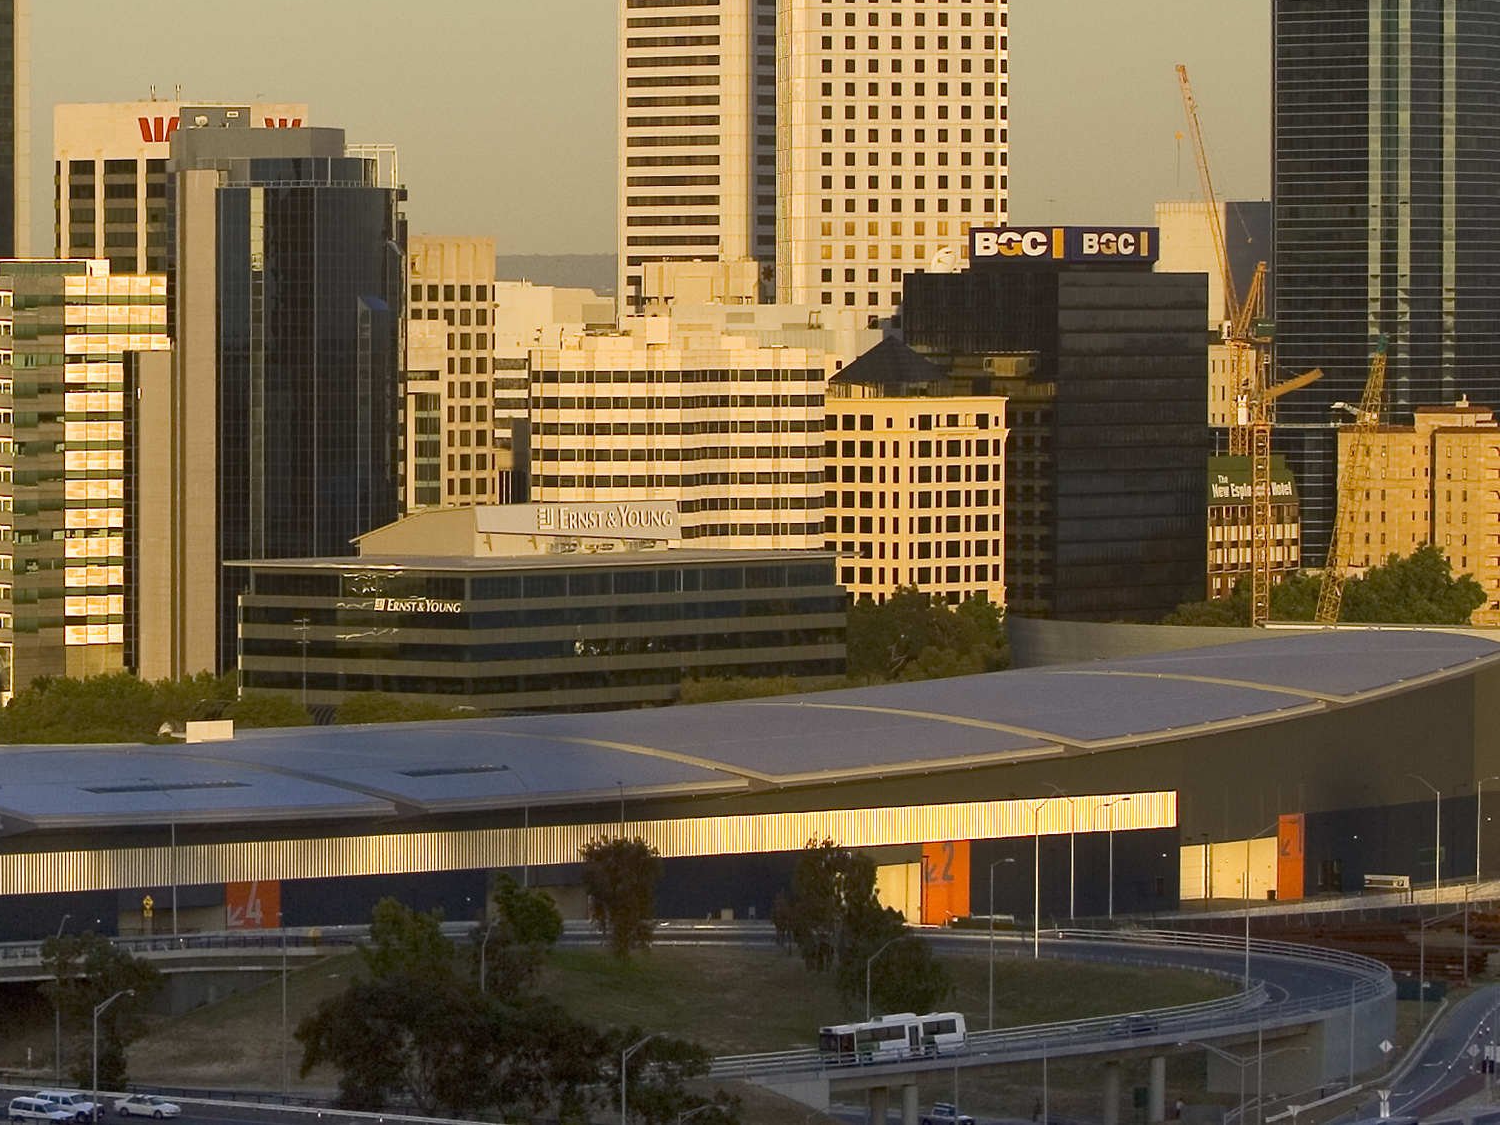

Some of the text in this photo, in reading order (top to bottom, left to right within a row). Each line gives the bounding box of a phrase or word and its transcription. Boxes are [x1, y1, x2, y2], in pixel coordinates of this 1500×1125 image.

[975, 231, 1048, 256] BGC
[1082, 233, 1135, 255] BGC
[1212, 484, 1230, 498] New
[1271, 481, 1293, 495] Hotel
[1217, 475, 1228, 484] The
[558, 504, 673, 530] ERNST & YOUNG
[386, 598, 417, 612] ERNST
[425, 599, 461, 613] YOUNG
[943, 842, 955, 882] 2
[246, 881, 263, 925] 4
